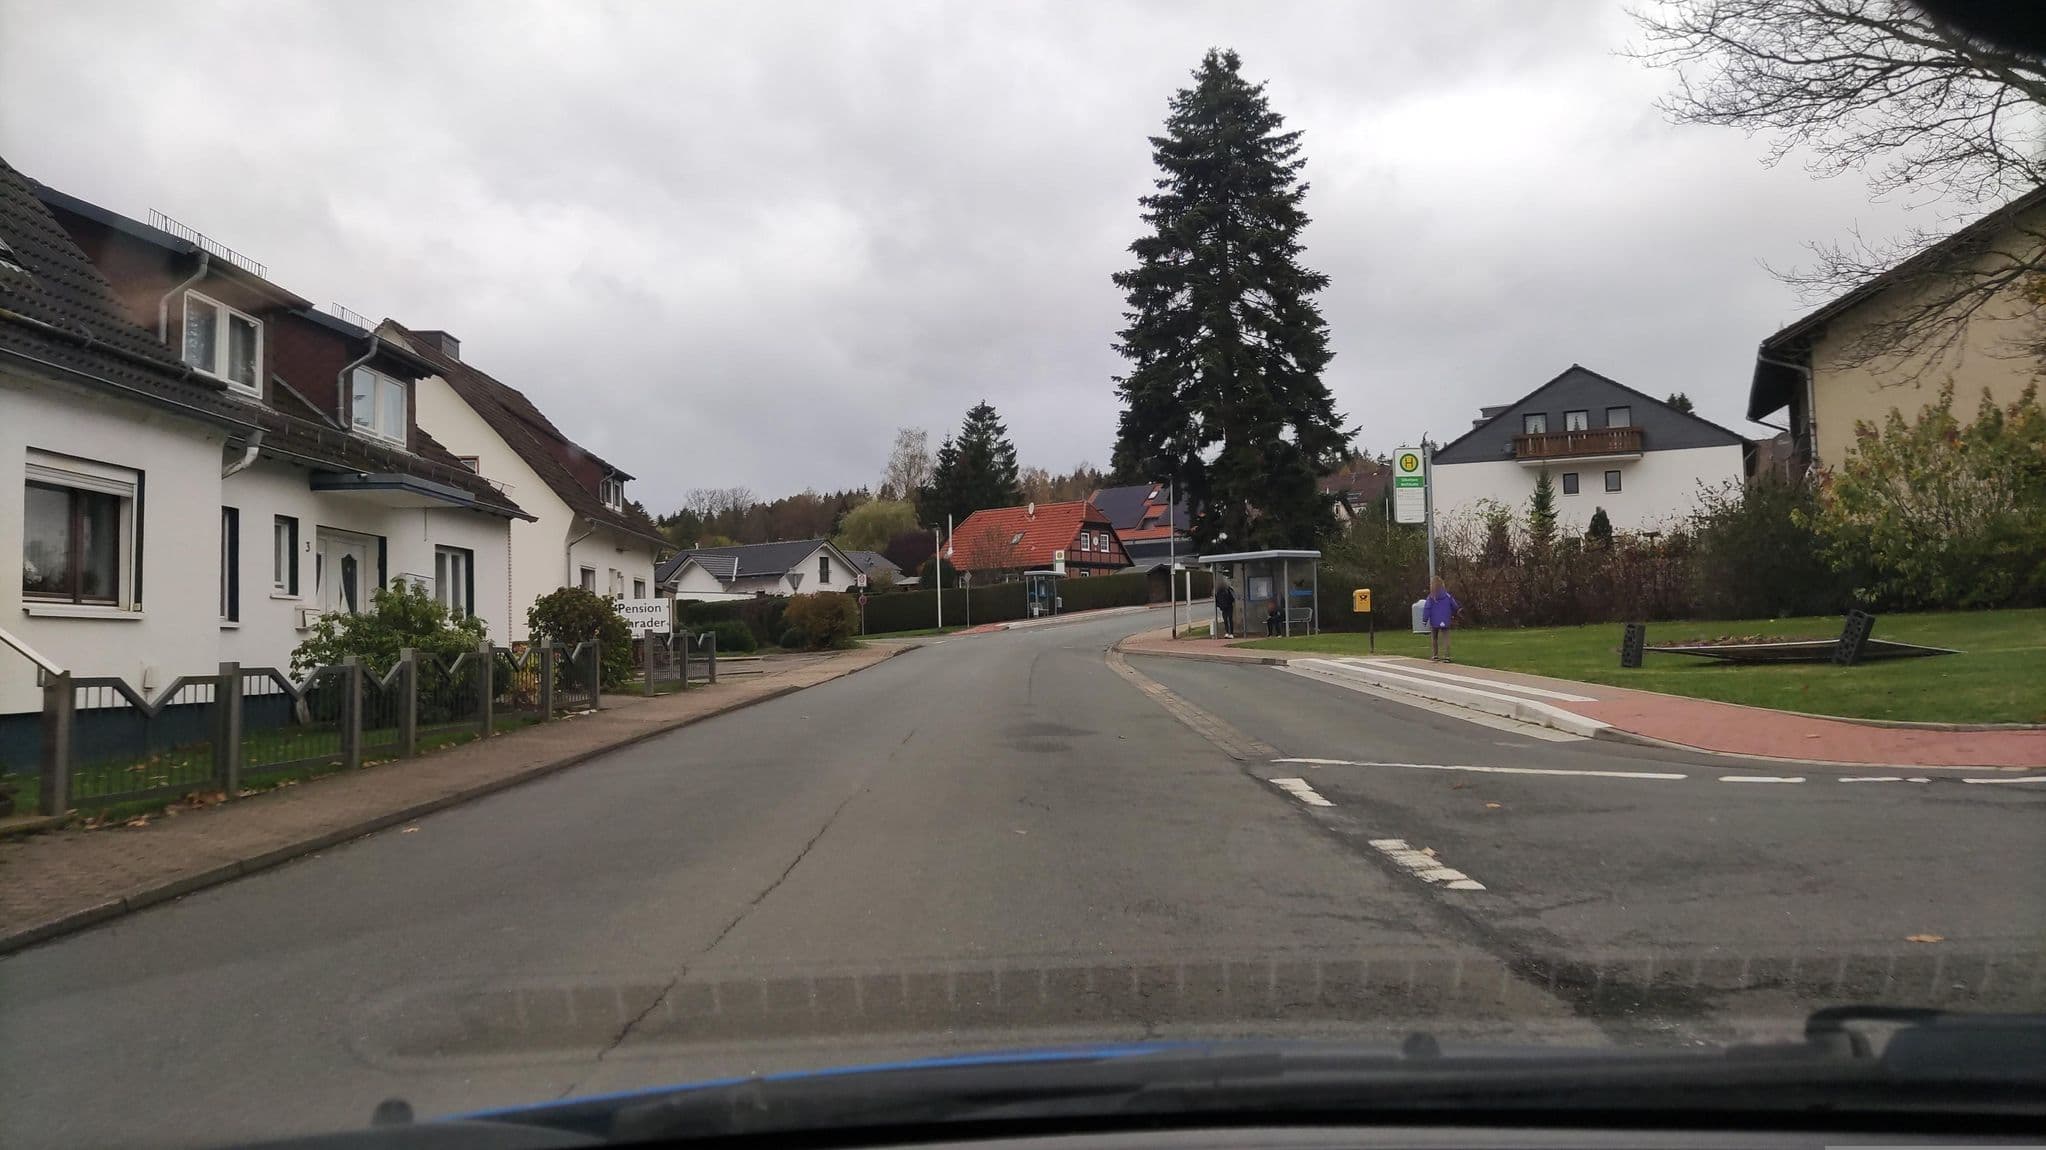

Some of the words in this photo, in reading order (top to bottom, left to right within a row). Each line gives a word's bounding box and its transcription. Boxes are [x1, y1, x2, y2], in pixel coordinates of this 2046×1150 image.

[305, 541, 311, 553] 3
[618, 603, 662, 614] Pension
[627, 617, 666, 628] hrader
